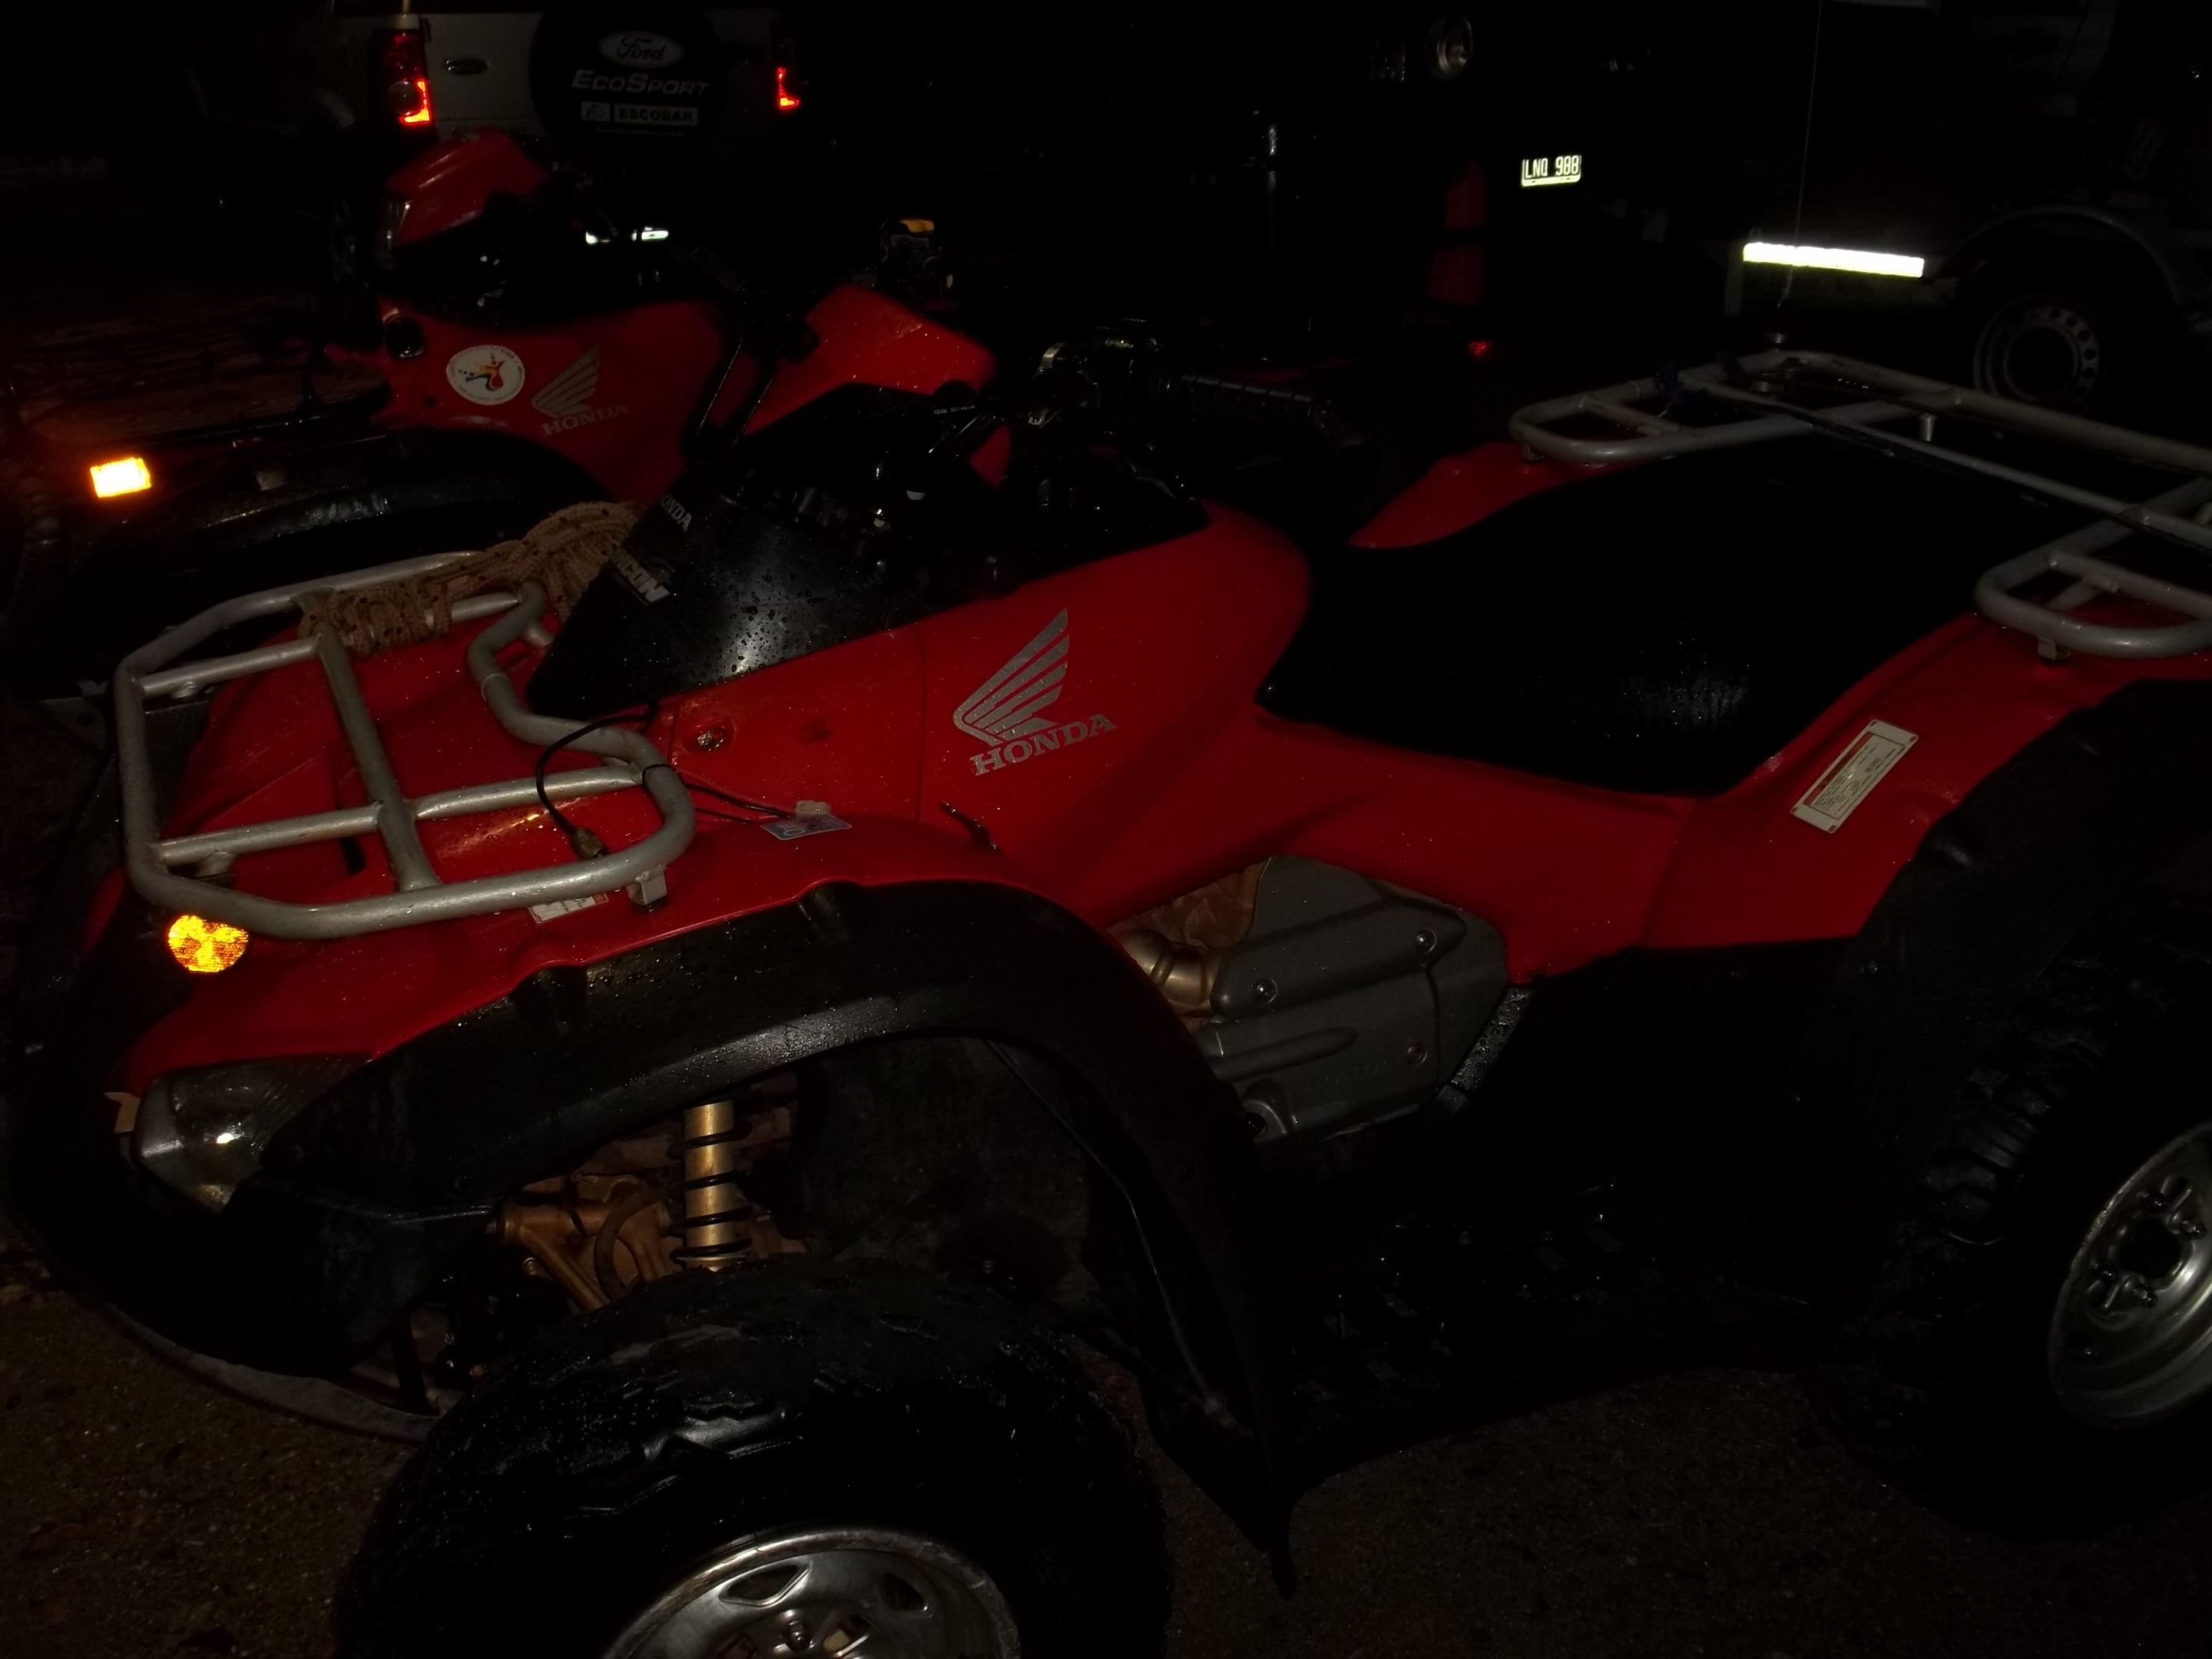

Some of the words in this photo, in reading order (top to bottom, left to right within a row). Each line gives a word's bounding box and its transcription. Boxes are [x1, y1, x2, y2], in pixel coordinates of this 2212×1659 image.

[616, 36, 667, 61] Ford
[619, 108, 693, 122] ESCOBAR
[1555, 154, 1579, 176] 988
[541, 403, 632, 437] HONDA
[969, 713, 1118, 777] HONDA
